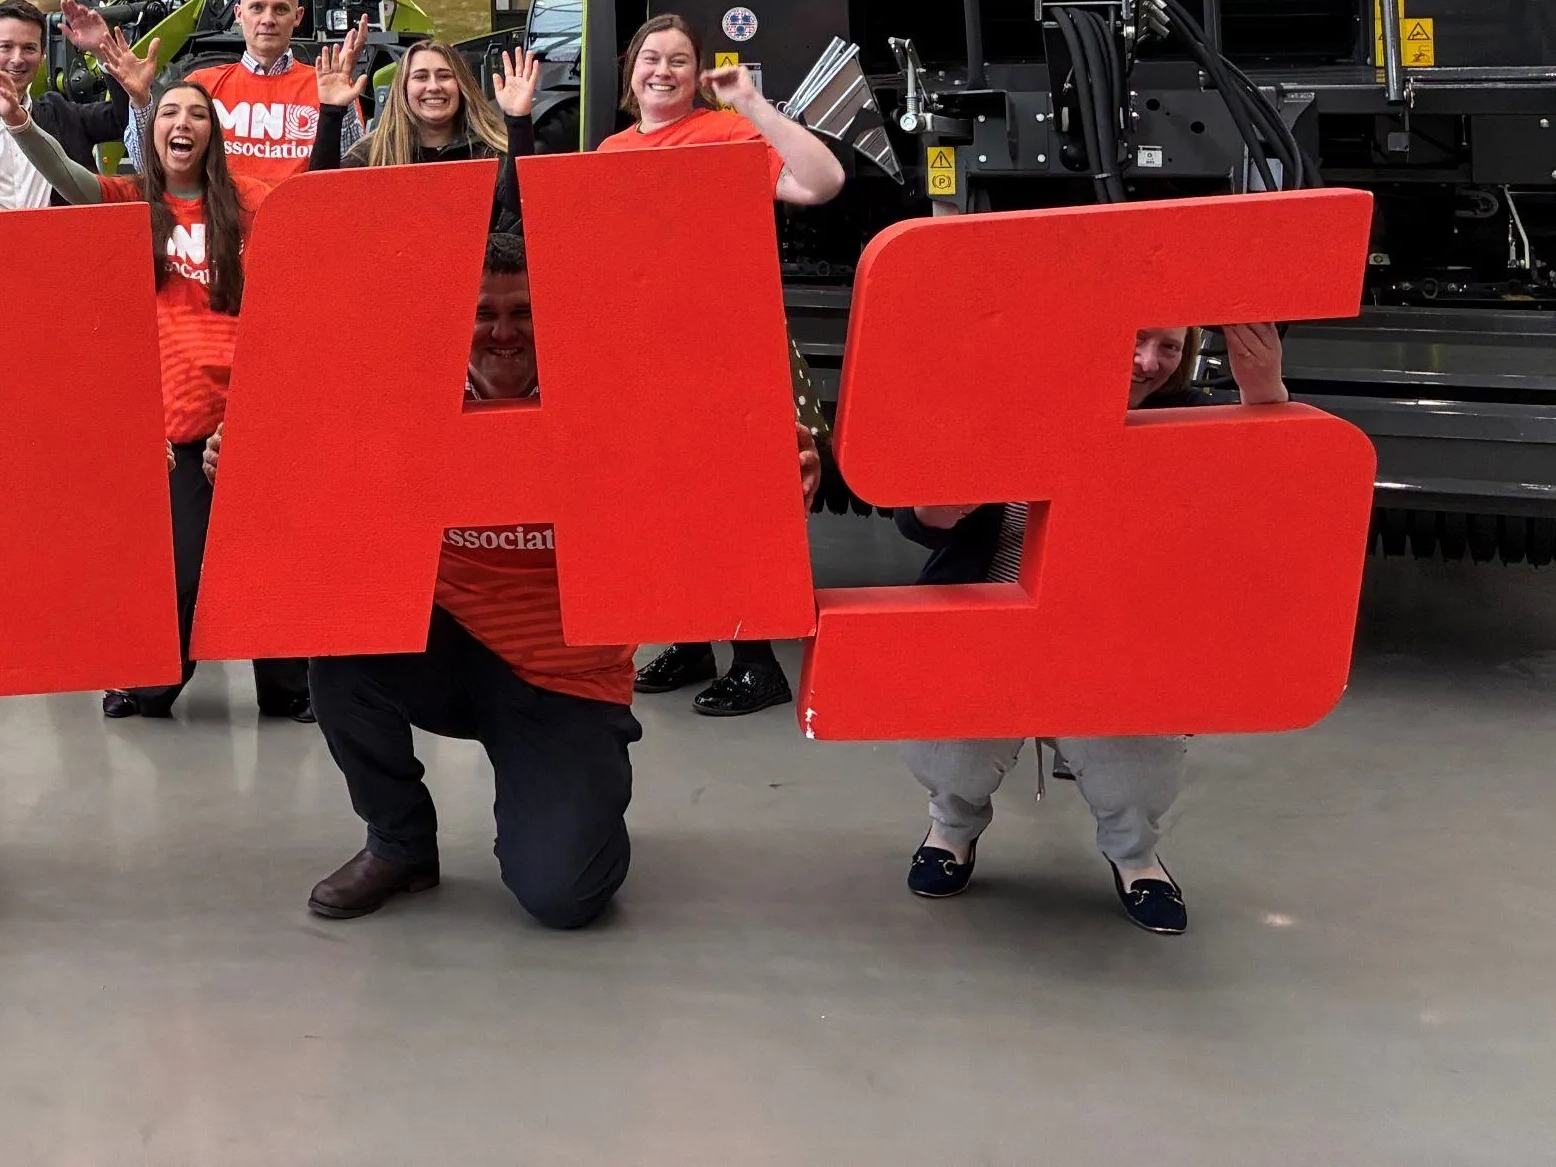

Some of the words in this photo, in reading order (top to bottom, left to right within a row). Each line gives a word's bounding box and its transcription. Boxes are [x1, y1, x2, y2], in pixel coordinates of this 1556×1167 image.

[212, 98, 320, 140] MND
[223, 140, 314, 159] ssociatio
[444, 525, 556, 550] ssociat
